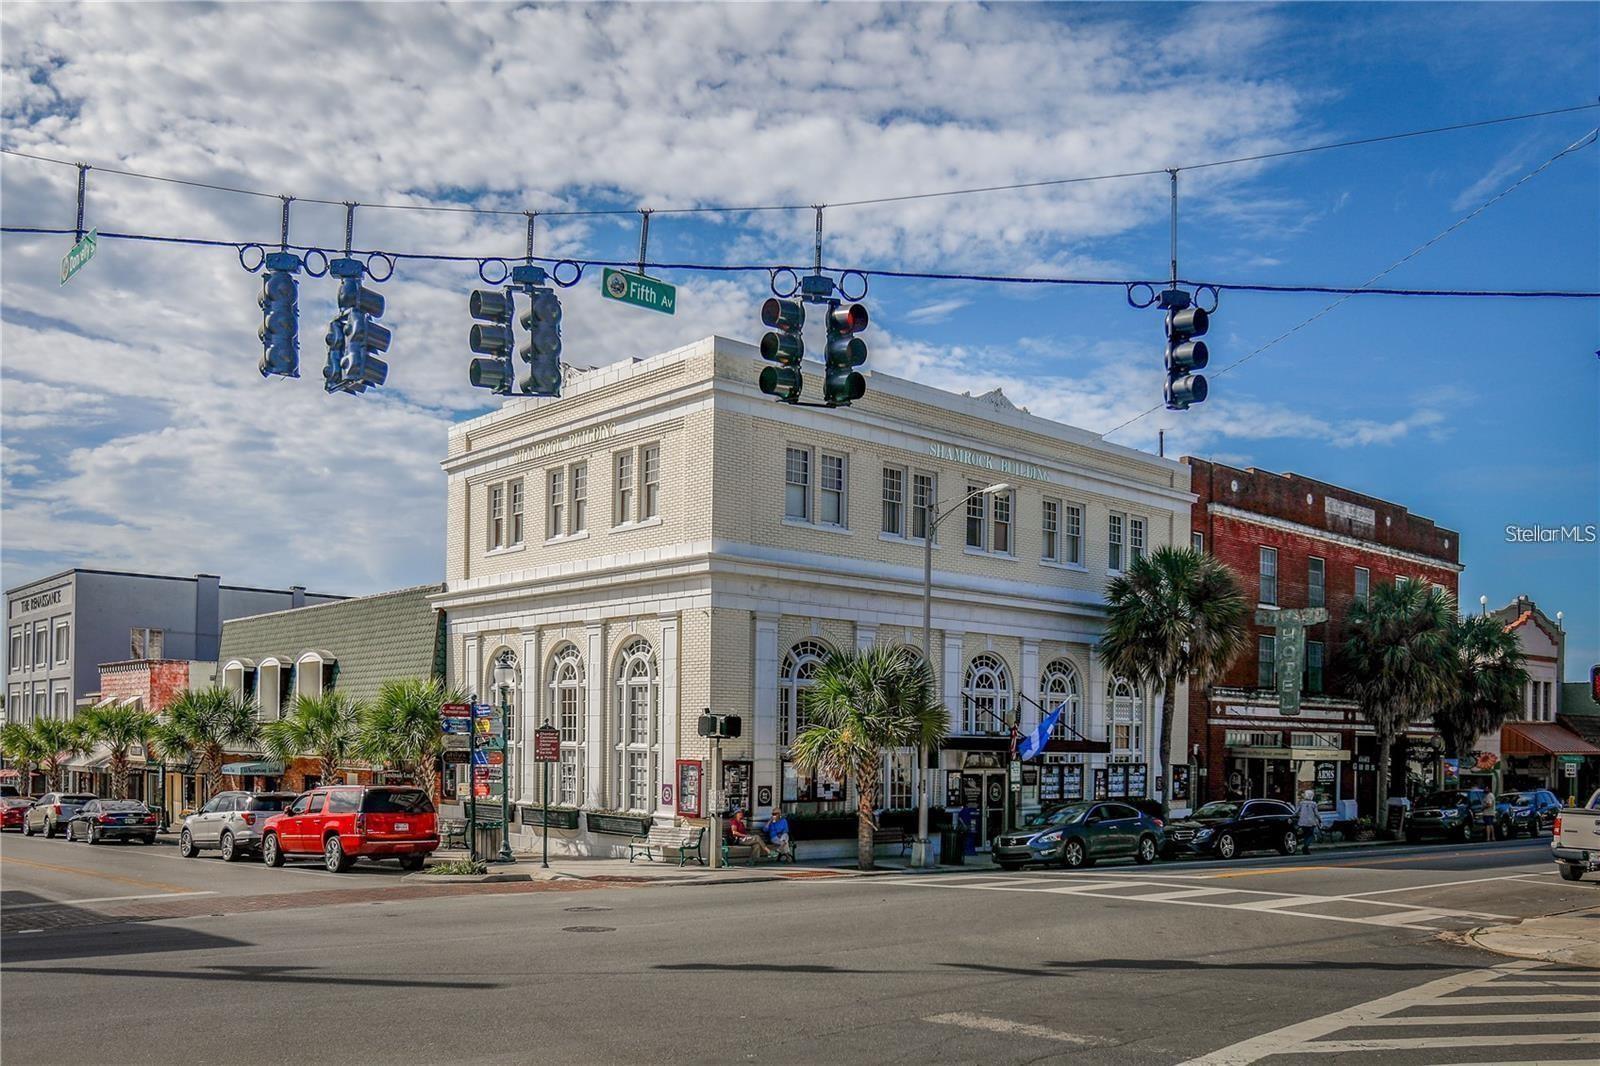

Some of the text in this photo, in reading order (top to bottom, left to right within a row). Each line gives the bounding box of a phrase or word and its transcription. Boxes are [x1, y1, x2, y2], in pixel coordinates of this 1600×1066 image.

[629, 281, 673, 308] Fifth Av
[514, 422, 617, 463] SHAMROCK BUILDING
[929, 443, 1050, 481] SHAMROCK BUILDING
